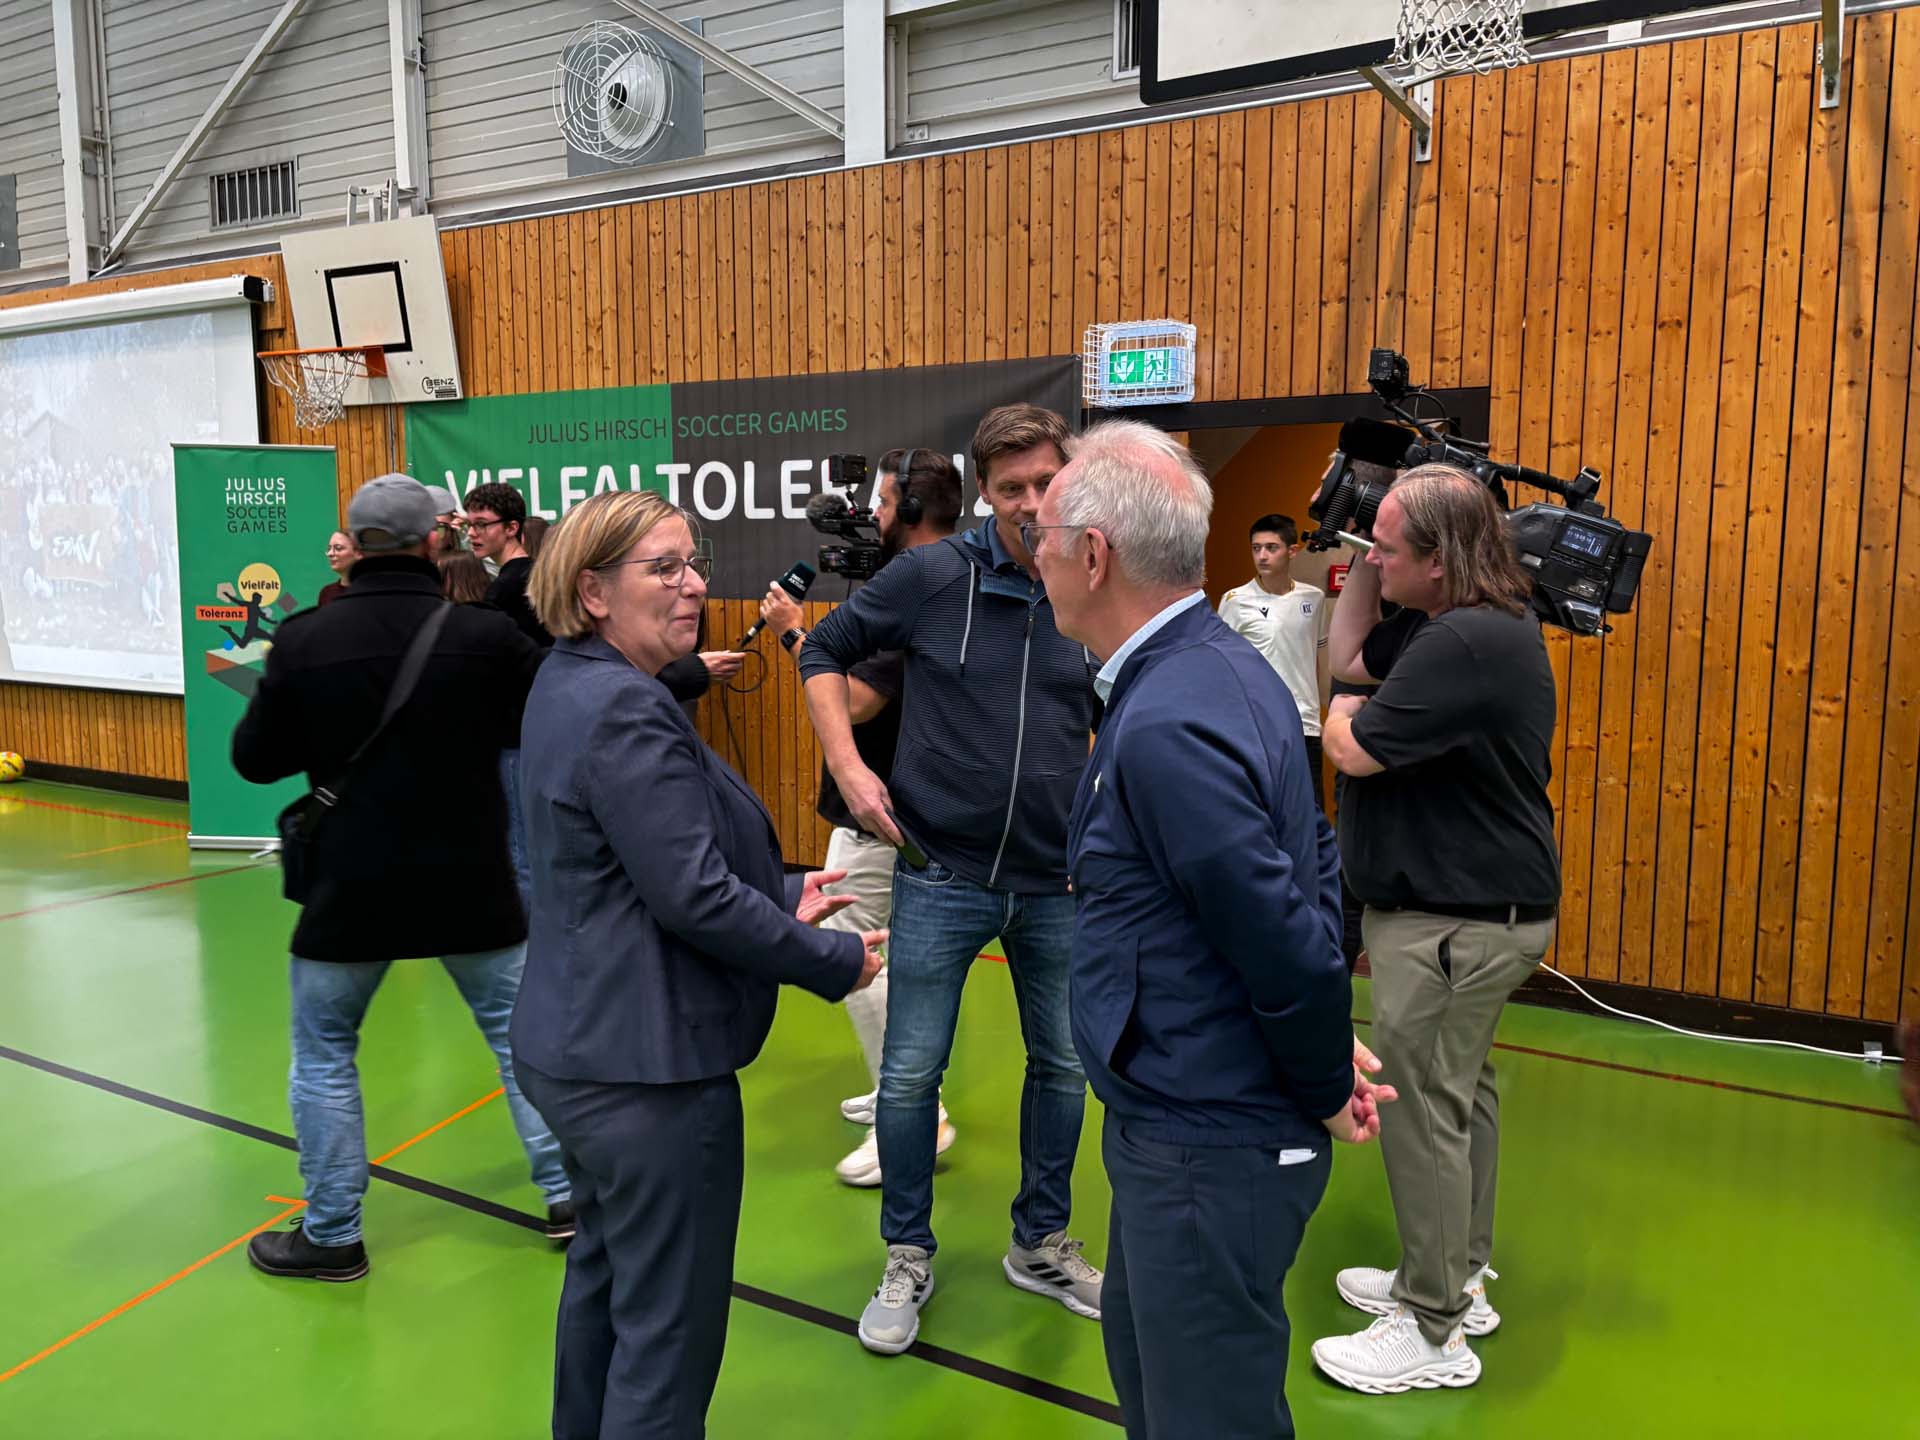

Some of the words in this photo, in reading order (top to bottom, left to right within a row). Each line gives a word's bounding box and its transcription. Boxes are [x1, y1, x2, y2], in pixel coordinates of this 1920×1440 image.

[528, 422, 589, 444] JULIUS
[595, 417, 667, 439] HIRSCH
[677, 413, 762, 438] SOCCER
[768, 408, 848, 433] GAMES
[225, 477, 286, 491] JULIUS
[226, 492, 286, 504] HIRSCH
[226, 506, 287, 519] SOCCER
[228, 520, 288, 533] GAMES
[241, 580, 279, 591] Vielfalt
[199, 608, 244, 619] Toleranz
